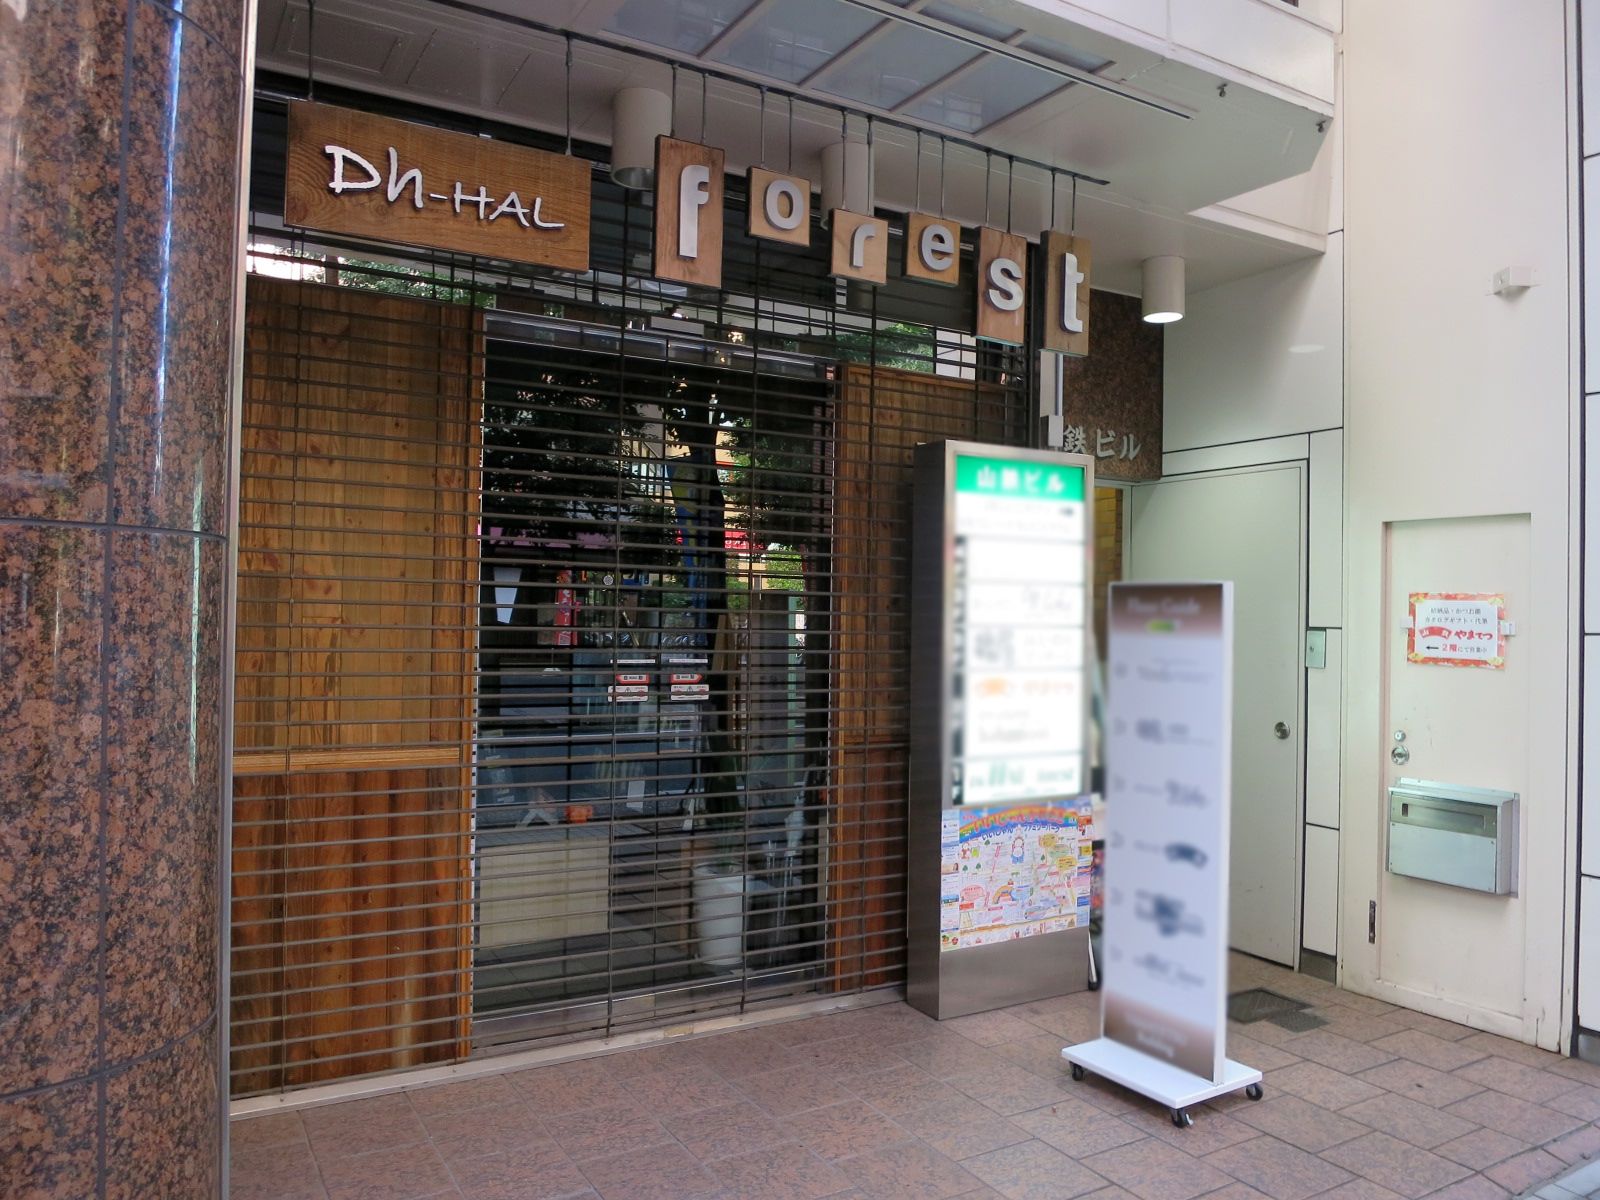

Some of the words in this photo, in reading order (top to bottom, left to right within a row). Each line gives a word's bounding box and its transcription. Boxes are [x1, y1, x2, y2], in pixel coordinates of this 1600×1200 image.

[678, 164, 1084, 334] forest
[1454, 630, 1493, 640] やまてつ
